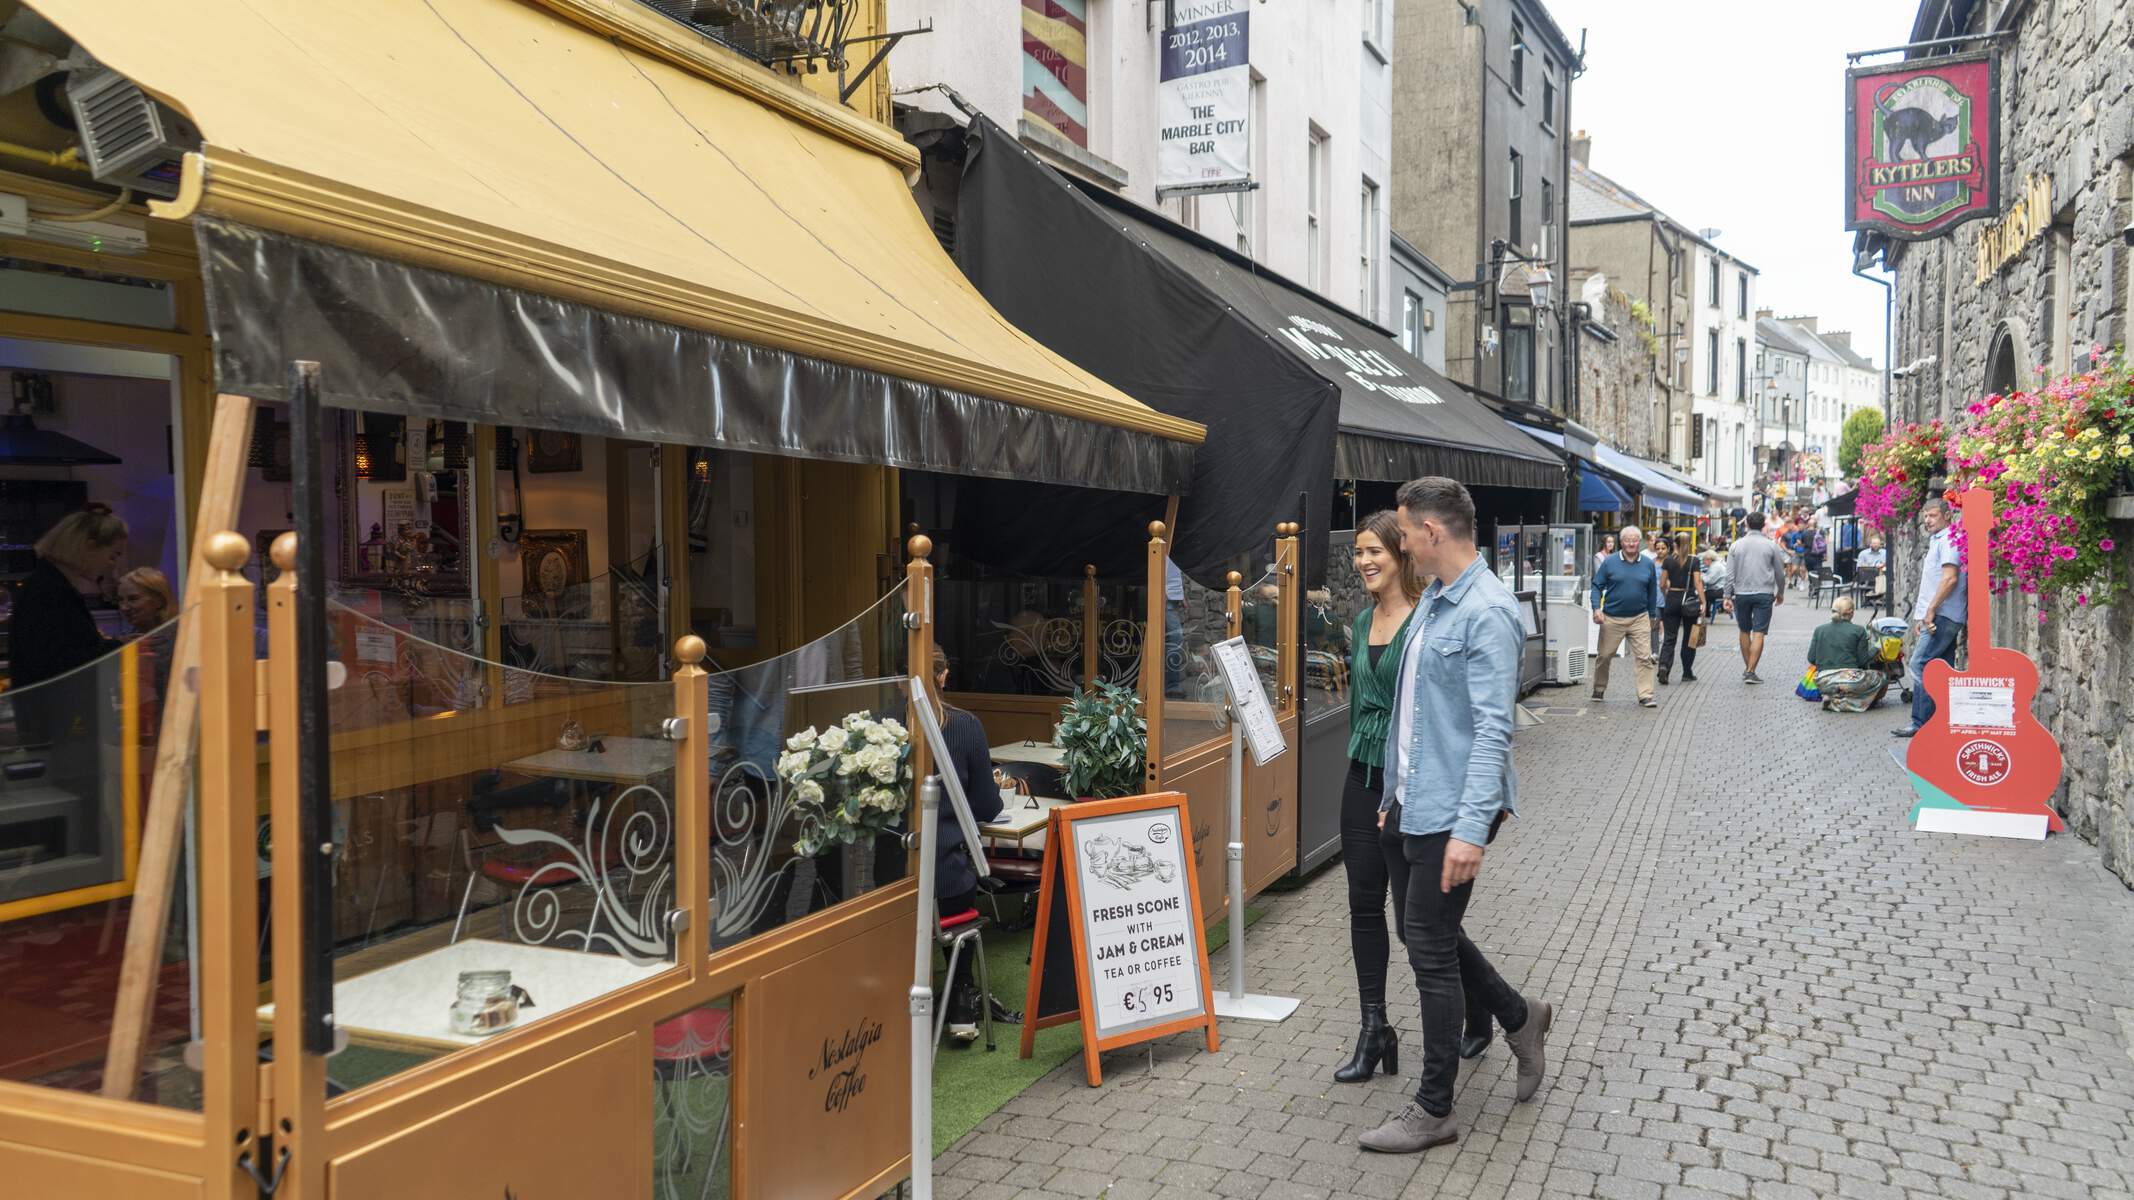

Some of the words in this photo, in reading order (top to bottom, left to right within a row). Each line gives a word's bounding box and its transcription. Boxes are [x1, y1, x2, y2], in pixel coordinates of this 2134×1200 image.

[1173, 0, 1233, 23] WINNER
[1169, 30, 1203, 49] 2012,
[1206, 22, 1241, 41] 2013,
[1184, 42, 1228, 69] 2014
[1190, 105, 1215, 119] THE
[1161, 123, 1213, 141] MARBLE
[1216, 119, 1245, 135] CITY
[1189, 140, 1215, 155] BAR
[1873, 156, 1973, 184] KYTELERS
[1905, 185, 1936, 202] INN
[1948, 677, 2016, 688] SMITHWICK'S
[1966, 769, 1987, 782] IRISH
[1988, 770, 2003, 782] ALE
[1093, 904, 1134, 922] FRESH
[1136, 896, 1180, 915] SCONE
[1126, 921, 1153, 935] WITH
[1096, 943, 1125, 960] JAM
[1129, 941, 1137, 954] &
[1140, 932, 1185, 952] CREAM
[1104, 967, 1124, 980] TEA
[1127, 963, 1141, 975] OR
[1144, 955, 1182, 972] COFFEE
[808, 1016, 882, 1080] Nostalgia
[825, 1067, 867, 1113] Coffee
